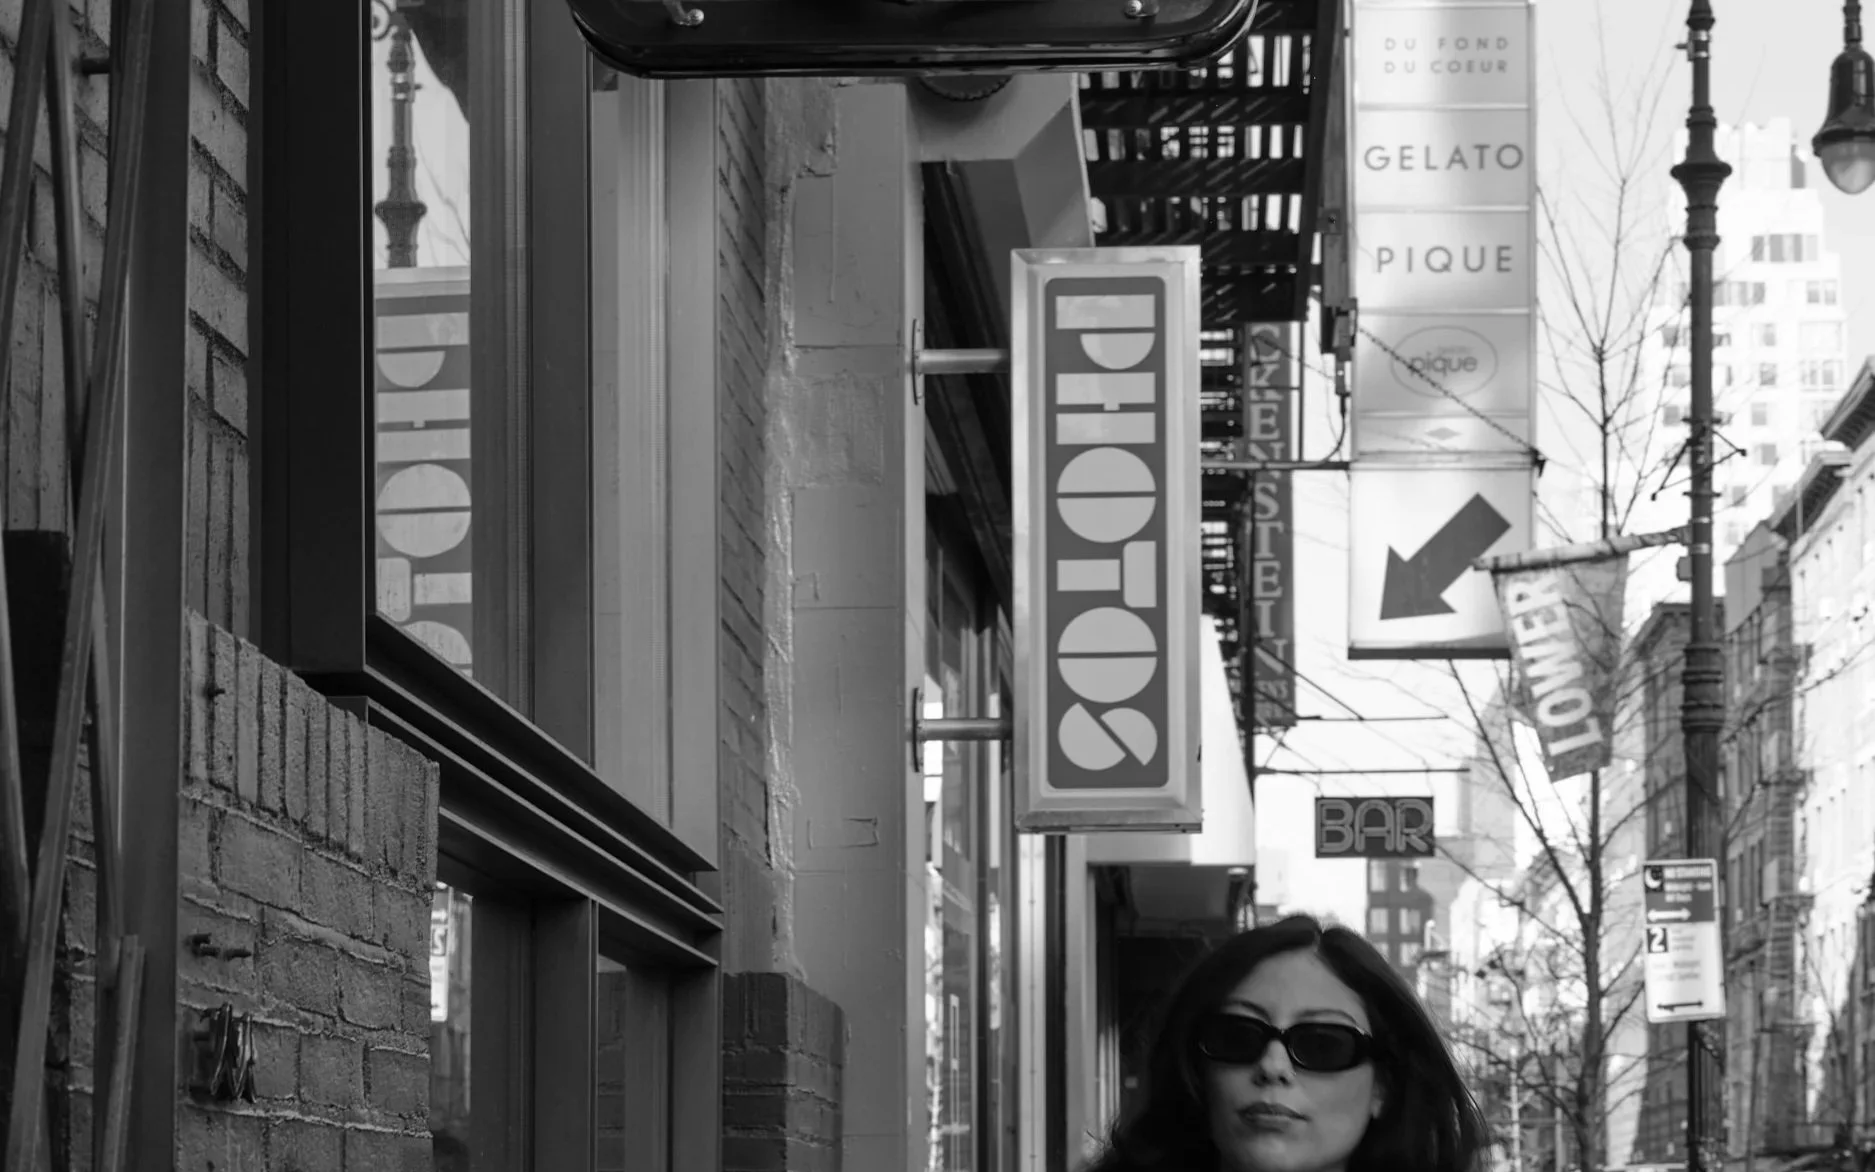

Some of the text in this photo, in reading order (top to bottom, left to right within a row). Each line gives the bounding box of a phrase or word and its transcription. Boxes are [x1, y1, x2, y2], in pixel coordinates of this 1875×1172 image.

[1384, 36, 1509, 51] DU FOND
[1384, 59, 1508, 74] DU COEUR
[1363, 143, 1524, 172] GELATO
[1376, 245, 1512, 273] PIQUE
[1409, 351, 1478, 378] pique
[1056, 294, 1158, 771] PHOTOS
[1505, 571, 1603, 757] LOWER
[1316, 799, 1434, 853] BAR
[1650, 927, 1665, 952] 2
